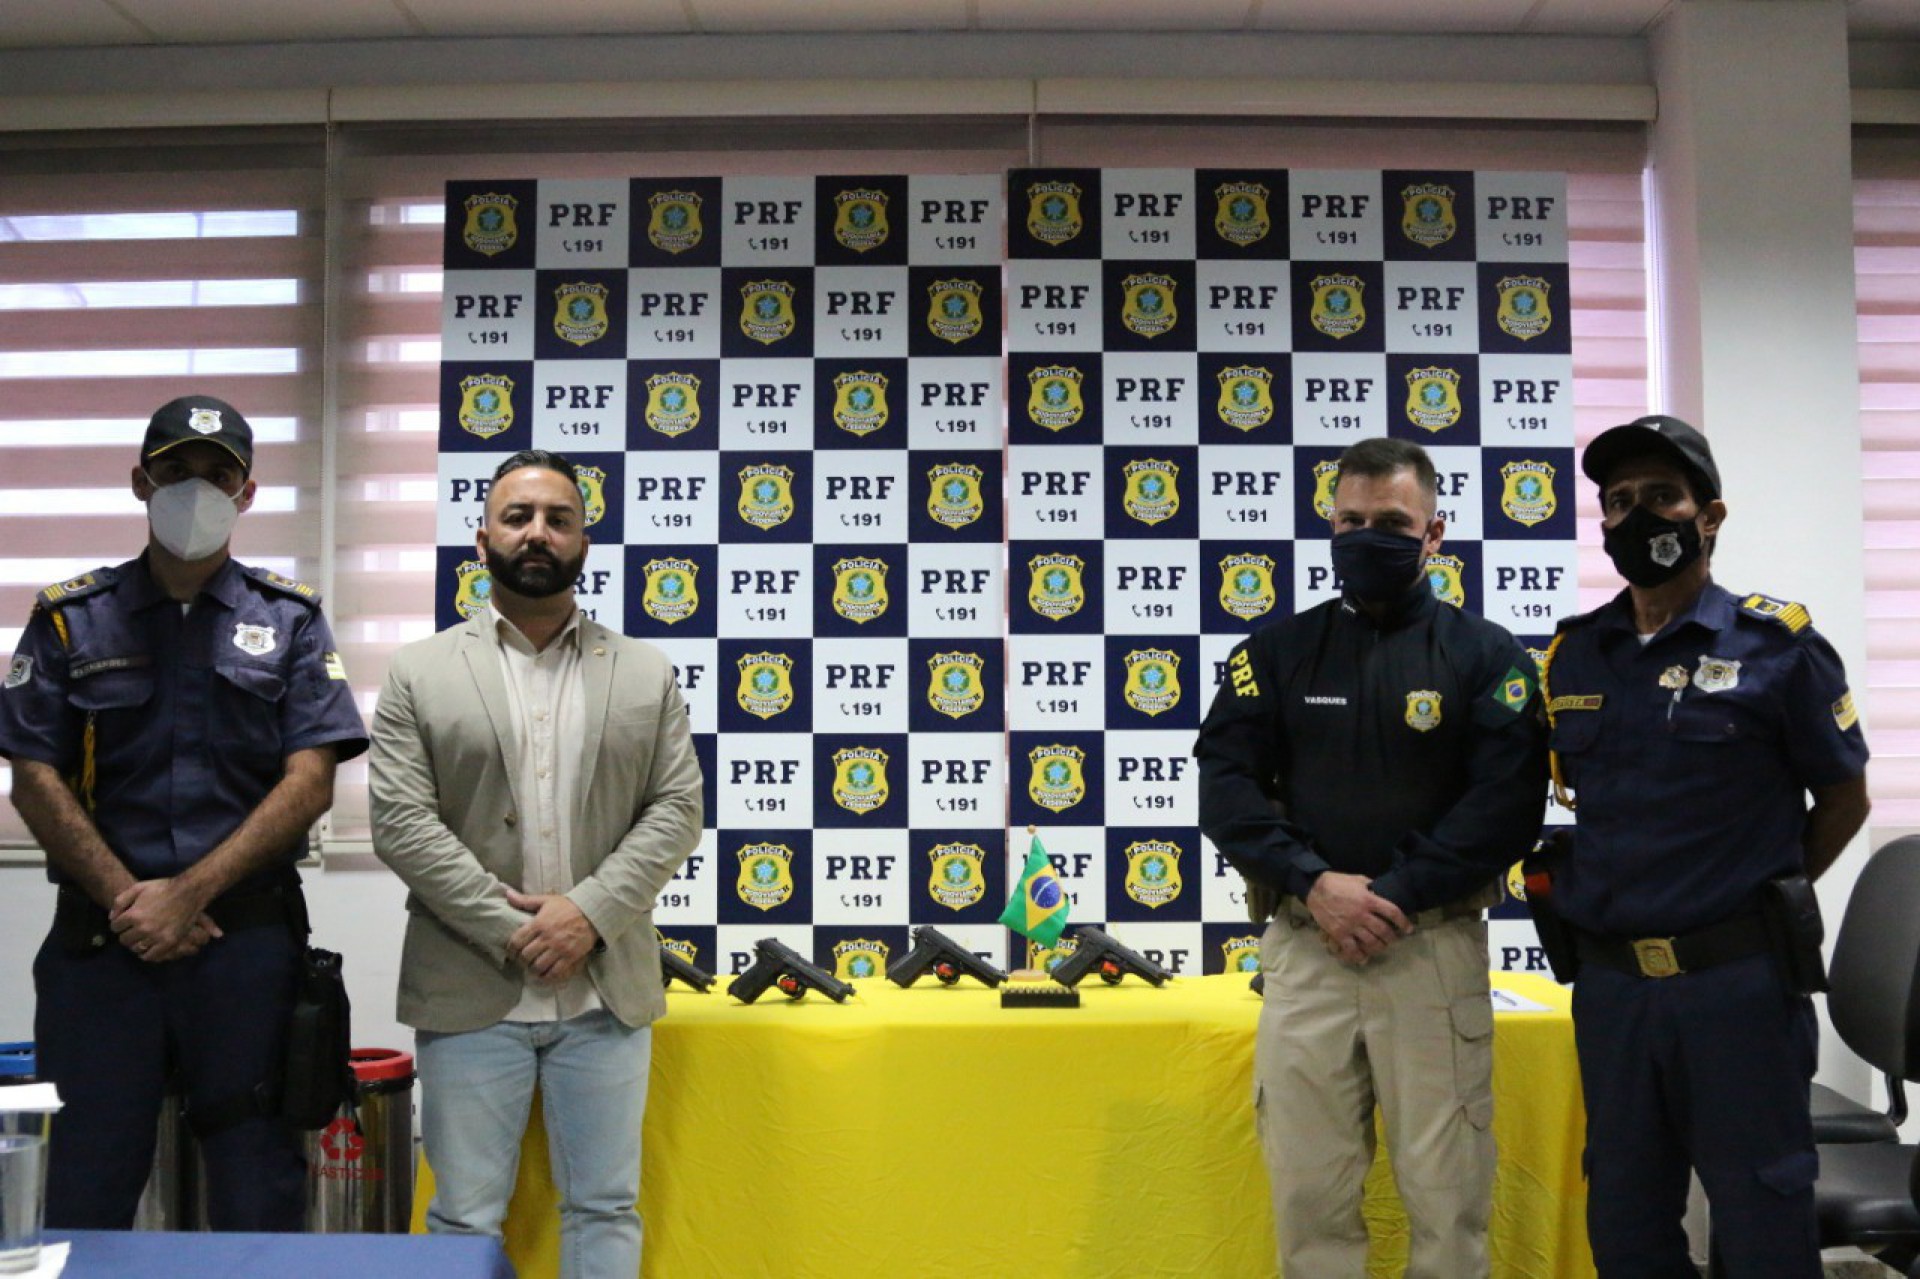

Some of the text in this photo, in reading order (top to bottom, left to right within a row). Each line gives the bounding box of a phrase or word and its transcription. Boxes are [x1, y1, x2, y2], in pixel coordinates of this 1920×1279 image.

[548, 203, 617, 227] PRF
[734, 201, 802, 225] PRF
[921, 200, 989, 224] PRF
[1114, 193, 1183, 217] PRF
[1301, 194, 1369, 219] PRF
[1487, 196, 1555, 220] PRF
[574, 239, 603, 253] 191
[760, 237, 789, 251] 191
[947, 236, 976, 250] 191
[1140, 230, 1169, 244] 191
[1328, 230, 1357, 244] 191
[1513, 233, 1542, 247] 191
[454, 294, 523, 319] PRF
[640, 292, 709, 317] PRF
[827, 291, 895, 316] PRF
[1020, 284, 1090, 310] PRF
[1209, 285, 1278, 310] PRF
[1397, 286, 1465, 311] PRF
[479, 330, 508, 344] 191
[665, 329, 694, 343] 191
[853, 327, 882, 341] 191
[1046, 321, 1076, 335] 191
[1235, 321, 1264, 336] 191
[1424, 323, 1453, 337] 191
[545, 384, 614, 409] PRF
[732, 383, 801, 408] PRF
[920, 382, 990, 407] PRF
[1115, 377, 1186, 402] PRF
[1305, 378, 1374, 403] PRF
[1492, 379, 1560, 404] PRF
[570, 422, 599, 436] 191
[758, 420, 787, 434] 191
[947, 419, 976, 433] 191
[1142, 414, 1171, 428] 191
[1331, 415, 1360, 429] 191
[1519, 416, 1547, 430] 191
[450, 478, 491, 503] PR
[638, 476, 706, 501] PRF
[826, 476, 895, 500] PRF
[1021, 471, 1091, 496] PRF
[1211, 471, 1281, 496] PRF
[663, 513, 691, 527] 191
[852, 513, 881, 527] 191
[1048, 509, 1077, 523] 191
[1238, 509, 1267, 523] 191
[573, 571, 611, 595] RF
[731, 570, 800, 595] PRF
[921, 569, 991, 594] PRF
[1117, 566, 1187, 591] PRF
[1496, 566, 1564, 591] PRF
[757, 608, 786, 621] 191
[947, 607, 976, 620] 191
[1143, 603, 1173, 617] 191
[1523, 603, 1552, 618] 191
[825, 664, 895, 689] PRF
[1022, 661, 1092, 686] PRF
[1229, 648, 1260, 697] PRF
[852, 702, 881, 716] 191
[1049, 699, 1078, 713] 191
[730, 759, 800, 785] PRF
[921, 759, 991, 784] PRF
[1118, 756, 1188, 782] PRF
[757, 798, 786, 812] 191
[948, 797, 977, 812] 191
[1145, 795, 1174, 809] 191
[826, 855, 896, 880] PRF
[660, 894, 691, 908] 191
[853, 894, 882, 908] 191
[1143, 949, 1189, 974] RF
[1501, 946, 1548, 971] PR
